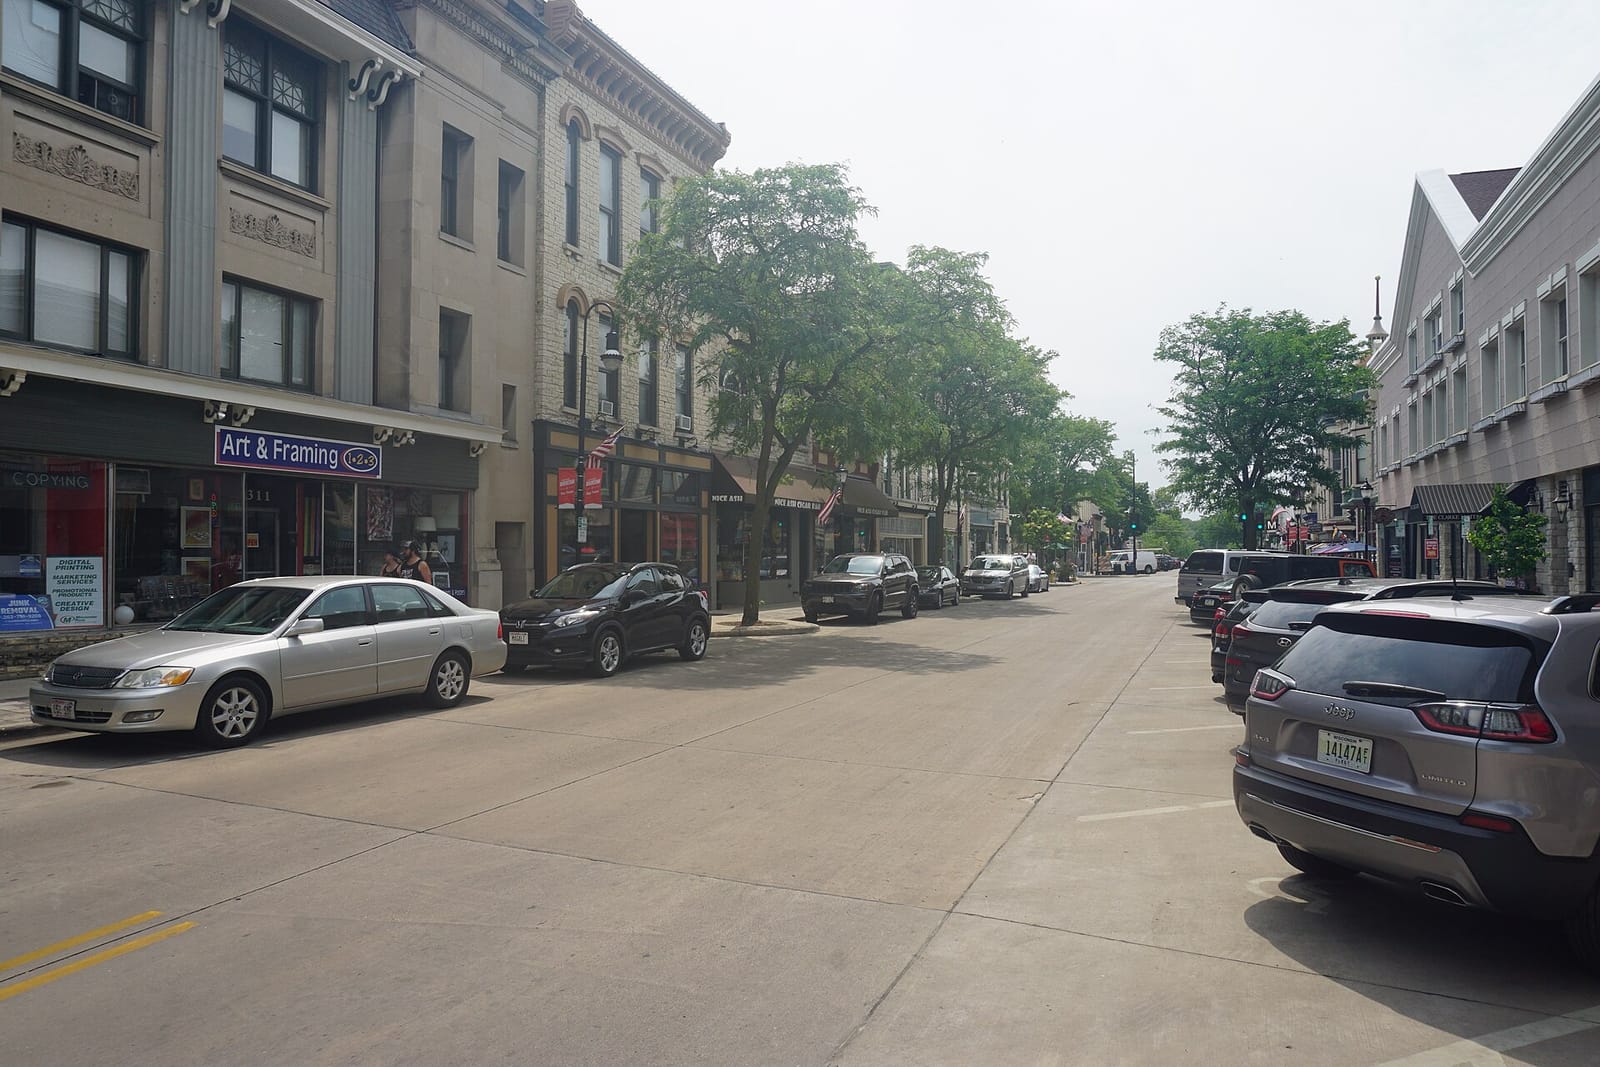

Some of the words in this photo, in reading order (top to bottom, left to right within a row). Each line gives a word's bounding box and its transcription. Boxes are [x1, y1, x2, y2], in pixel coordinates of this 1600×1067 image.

[222, 433, 250, 458] Art
[256, 436, 268, 460] &
[273, 439, 338, 470] Framing
[12, 471, 89, 489] COPYING
[247, 489, 270, 501] 311
[0, 607, 40, 615] REMOVAL
[8, 599, 31, 607] JUNK
[1324, 702, 1356, 721] Jeep
[1325, 740, 1363, 764] 14147A
